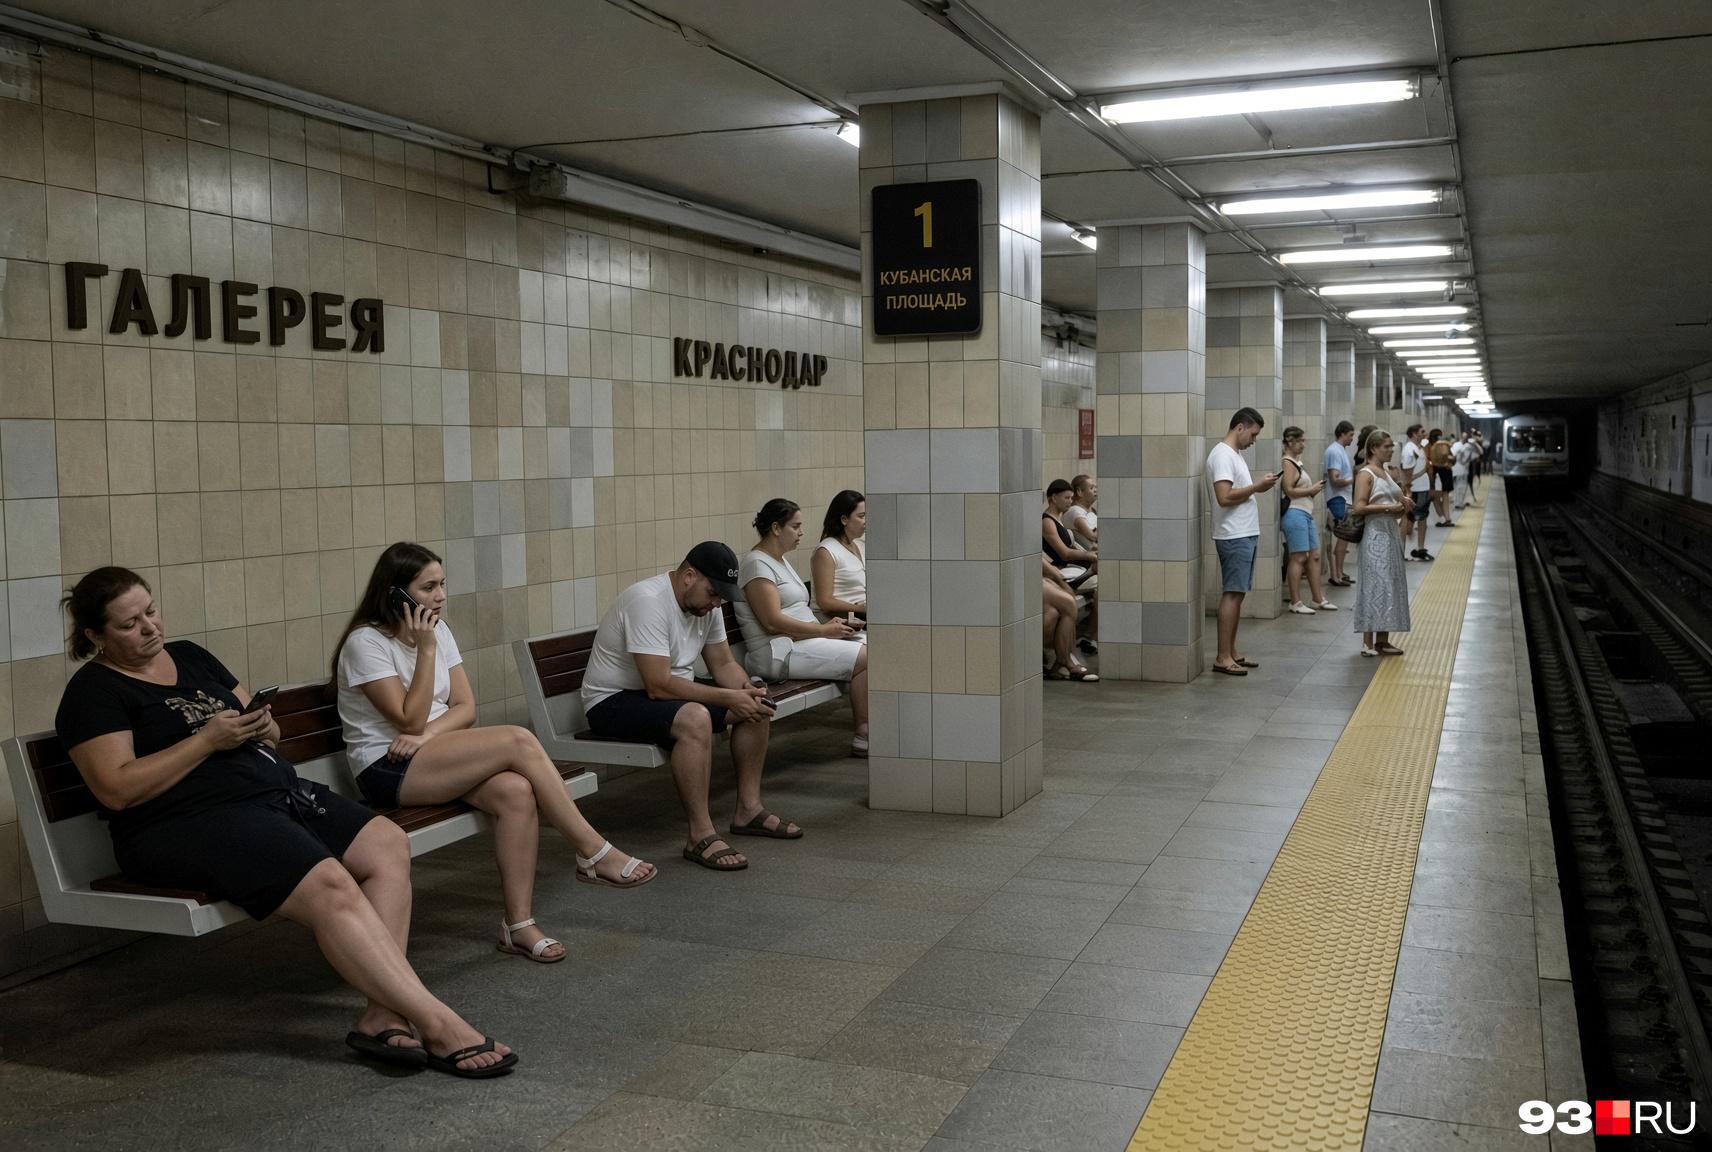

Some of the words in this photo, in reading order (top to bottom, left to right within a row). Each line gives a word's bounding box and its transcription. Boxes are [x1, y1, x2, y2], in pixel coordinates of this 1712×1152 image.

[914, 201, 933, 248] 1
[880, 267, 972, 285] КУБАНСКАЯ
[65, 262, 385, 352] ГАЛЕРЕЯ
[886, 293, 967, 311] ПЛОЩАДЬ
[673, 337, 828, 390] КРАСНОДАР
